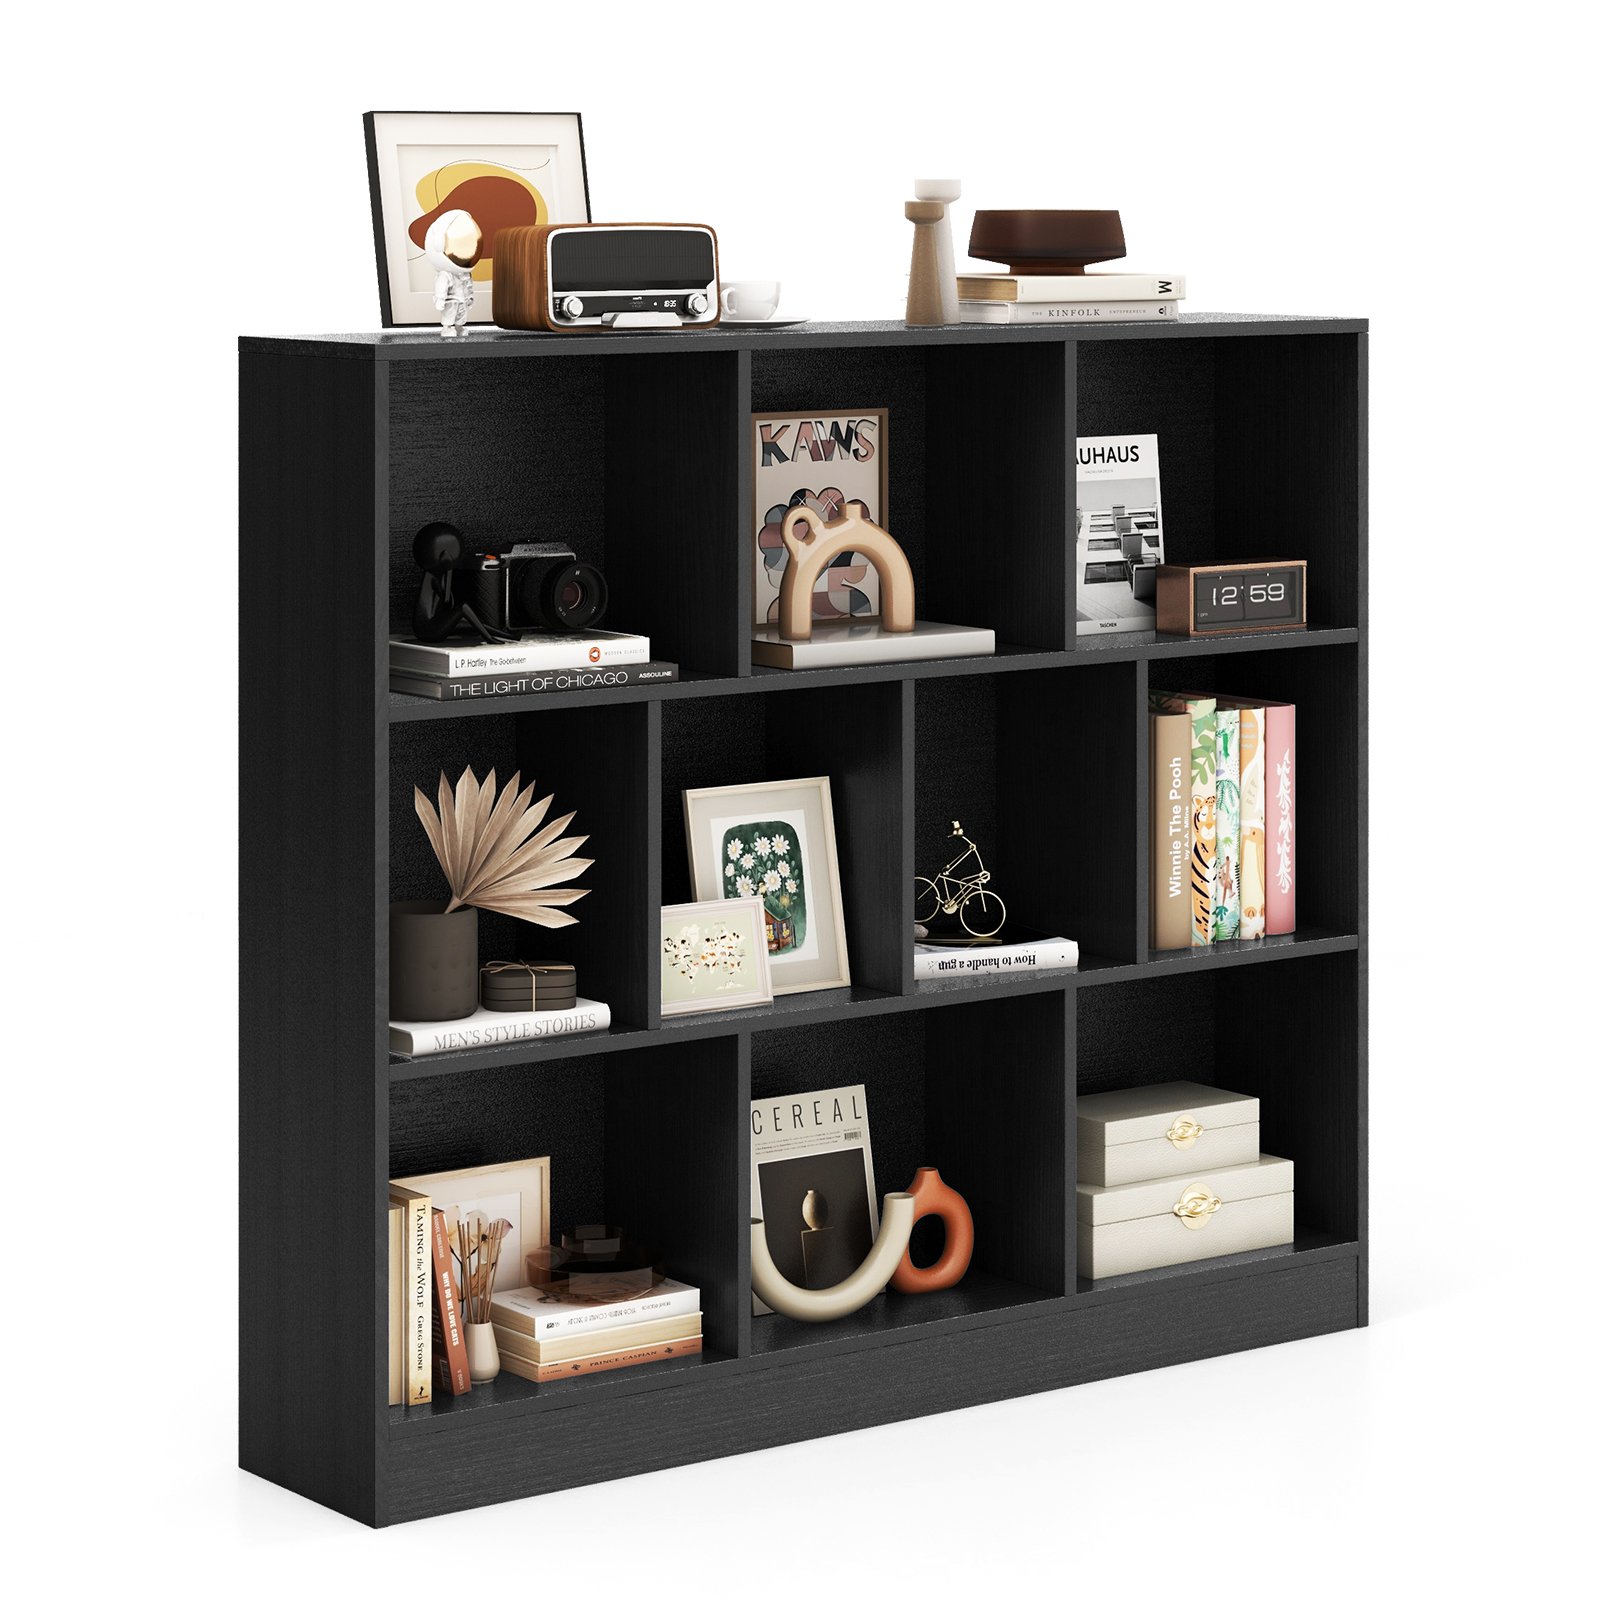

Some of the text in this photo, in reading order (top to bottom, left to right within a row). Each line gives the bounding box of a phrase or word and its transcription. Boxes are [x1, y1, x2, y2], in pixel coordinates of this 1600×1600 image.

[1048, 308, 1101, 317] KINFOLK
[758, 418, 878, 467] KAWS
[1076, 445, 1140, 465] UHAUS
[467, 657, 488, 669] Hartley
[638, 670, 673, 679] ASSOULINE
[450, 671, 629, 697] THE LIGHT OF CHICAGO
[1169, 756, 1182, 898] Winnie The Pooh
[1184, 849, 1190, 861] by
[958, 960, 965, 969] a
[966, 957, 1000, 971] handle
[1002, 956, 1012, 966] to
[1014, 954, 1037, 966] How
[434, 1013, 596, 1051] MEN'S STYLE STORIES
[751, 1095, 863, 1135] CEREAL
[416, 1204, 426, 1308] TAMING the WOLF
[442, 1271, 451, 1288] WHY
[446, 1299, 454, 1311] WE
[448, 1311, 457, 1329] LOVE
[416, 1315, 425, 1372] GREG STONE
[451, 1328, 460, 1347] CATS
[589, 1350, 657, 1367] PRINCE CASPIAN
